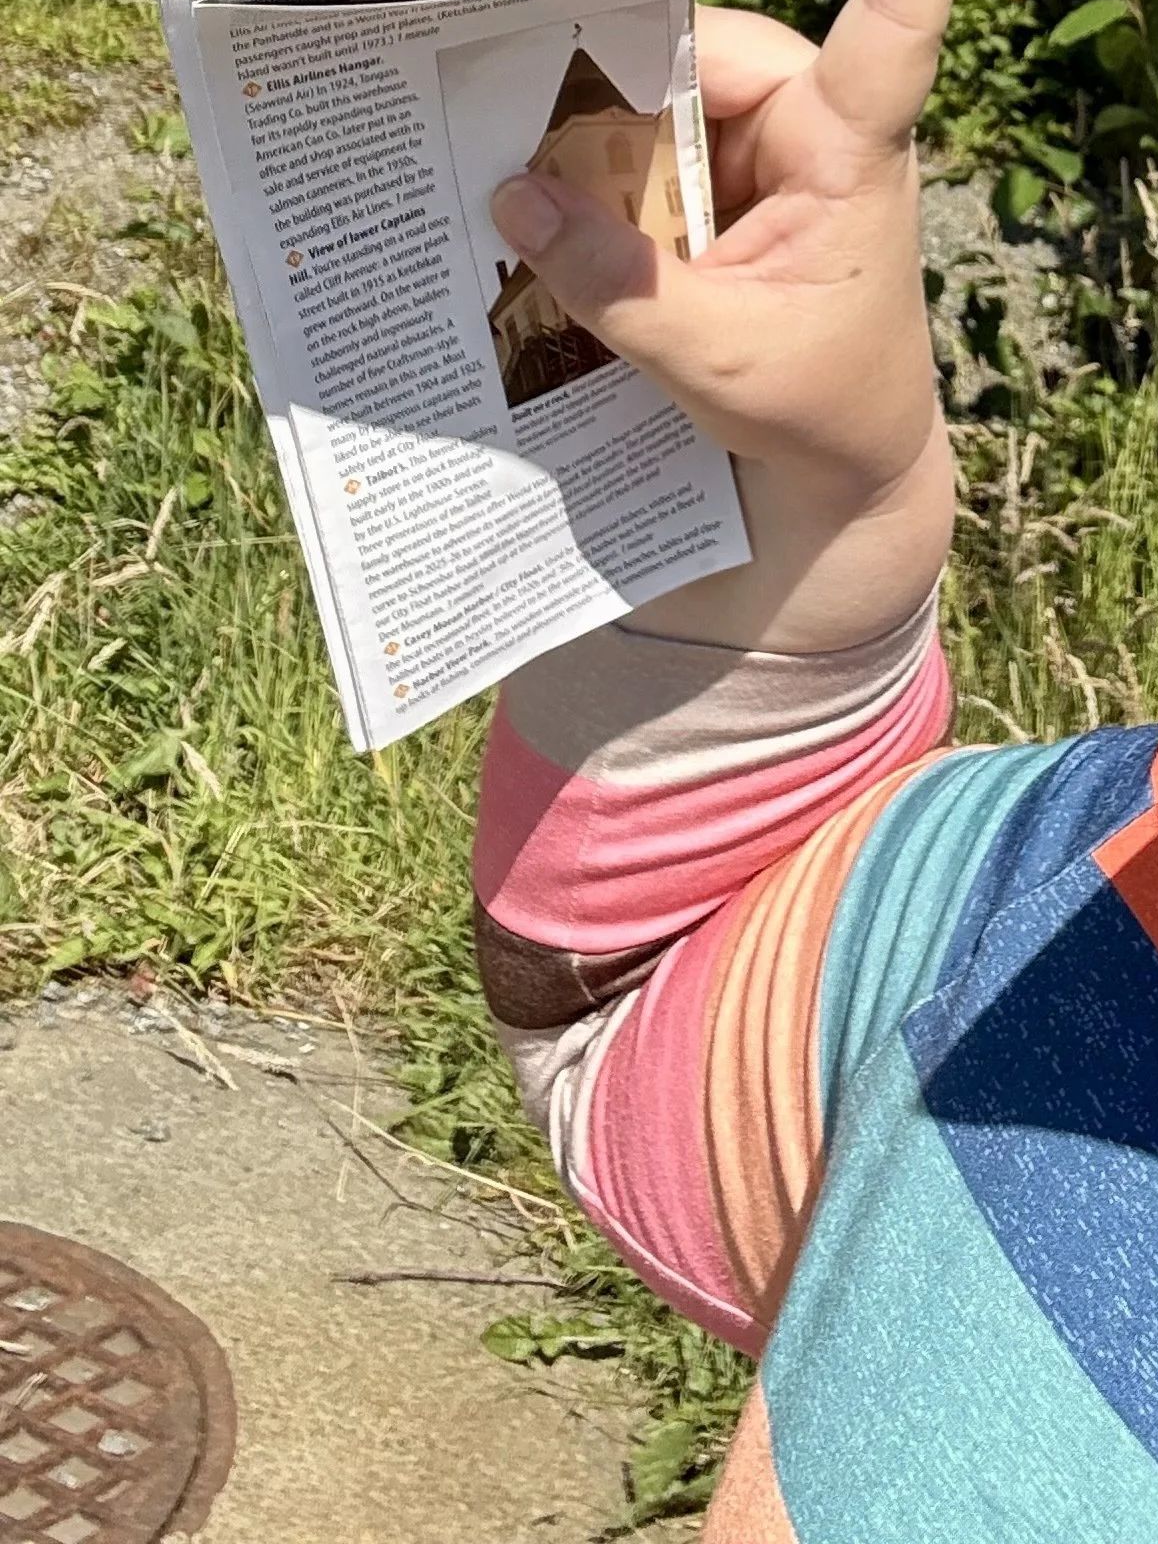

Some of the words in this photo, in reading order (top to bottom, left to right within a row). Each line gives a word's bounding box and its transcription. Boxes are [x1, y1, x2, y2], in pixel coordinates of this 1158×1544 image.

[234, 46, 292, 67] passengers
[295, 34, 331, 50] caught
[333, 31, 357, 45] prop
[360, 23, 380, 36] and
[311, 22, 330, 33] and
[238, 64, 268, 80] Island
[272, 55, 304, 71] wasn't
[308, 49, 330, 63] built
[334, 43, 358, 57] until
[266, 78, 290, 91] Ellis
[293, 68, 335, 84] Airlines
[244, 92, 292, 116] (Seawind
[296, 86, 312, 99] Air)
[330, 76, 357, 90] 1924,
[360, 66, 399, 82] Tongass
[247, 113, 286, 129] Trading
[289, 107, 302, 118] Co.
[305, 98, 328, 113] built
[331, 94, 350, 106] this
[352, 80, 407, 100] warehouse
[251, 135, 264, 145] for
[268, 129, 280, 140] its
[283, 119, 317, 136] rapidly
[320, 105, 372, 125] expanding
[256, 142, 302, 161] American
[305, 136, 322, 147] Can
[342, 124, 364, 136] later
[367, 115, 384, 131] put
[386, 113, 396, 123] in
[399, 110, 411, 119] an
[260, 164, 286, 178] office
[289, 155, 307, 169] and
[310, 150, 332, 162] shop
[336, 131, 386, 154] associated
[388, 123, 410, 138] with
[412, 120, 424, 131] its
[263, 182, 282, 195] sale
[285, 173, 304, 188] and
[305, 165, 338, 181] service
[341, 157, 351, 169] of
[353, 139, 407, 166] equipment
[408, 137, 421, 147] for
[269, 196, 304, 213] salmon
[368, 167, 383, 179] the
[274, 220, 290, 232] the
[292, 205, 332, 225] building
[333, 198, 352, 210] was
[354, 176, 402, 206] purchased
[403, 174, 415, 185] by
[418, 168, 433, 180] the
[280, 224, 330, 248] expanding
[352, 208, 364, 221] Air
[307, 244, 334, 259] View
[336, 234, 347, 247] of
[380, 208, 425, 231] Captains
[288, 270, 311, 286] Hill.
[405, 222, 426, 240] road
[294, 283, 320, 302] called
[298, 298, 326, 319] street
[326, 289, 349, 307] built
[350, 287, 360, 298] in
[362, 275, 384, 293] 1915
[386, 273, 396, 283] as
[303, 320, 326, 338] grew
[380, 291, 393, 303] On
[395, 284, 411, 297] the
[412, 274, 437, 289] water
[306, 341, 319, 351] on
[321, 333, 336, 345] the
[339, 321, 356, 338] rock
[358, 312, 380, 330] high
[310, 340, 359, 367] stubbornly
[361, 331, 379, 347] and
[315, 353, 365, 383] challenged
[366, 339, 399, 362] natural
